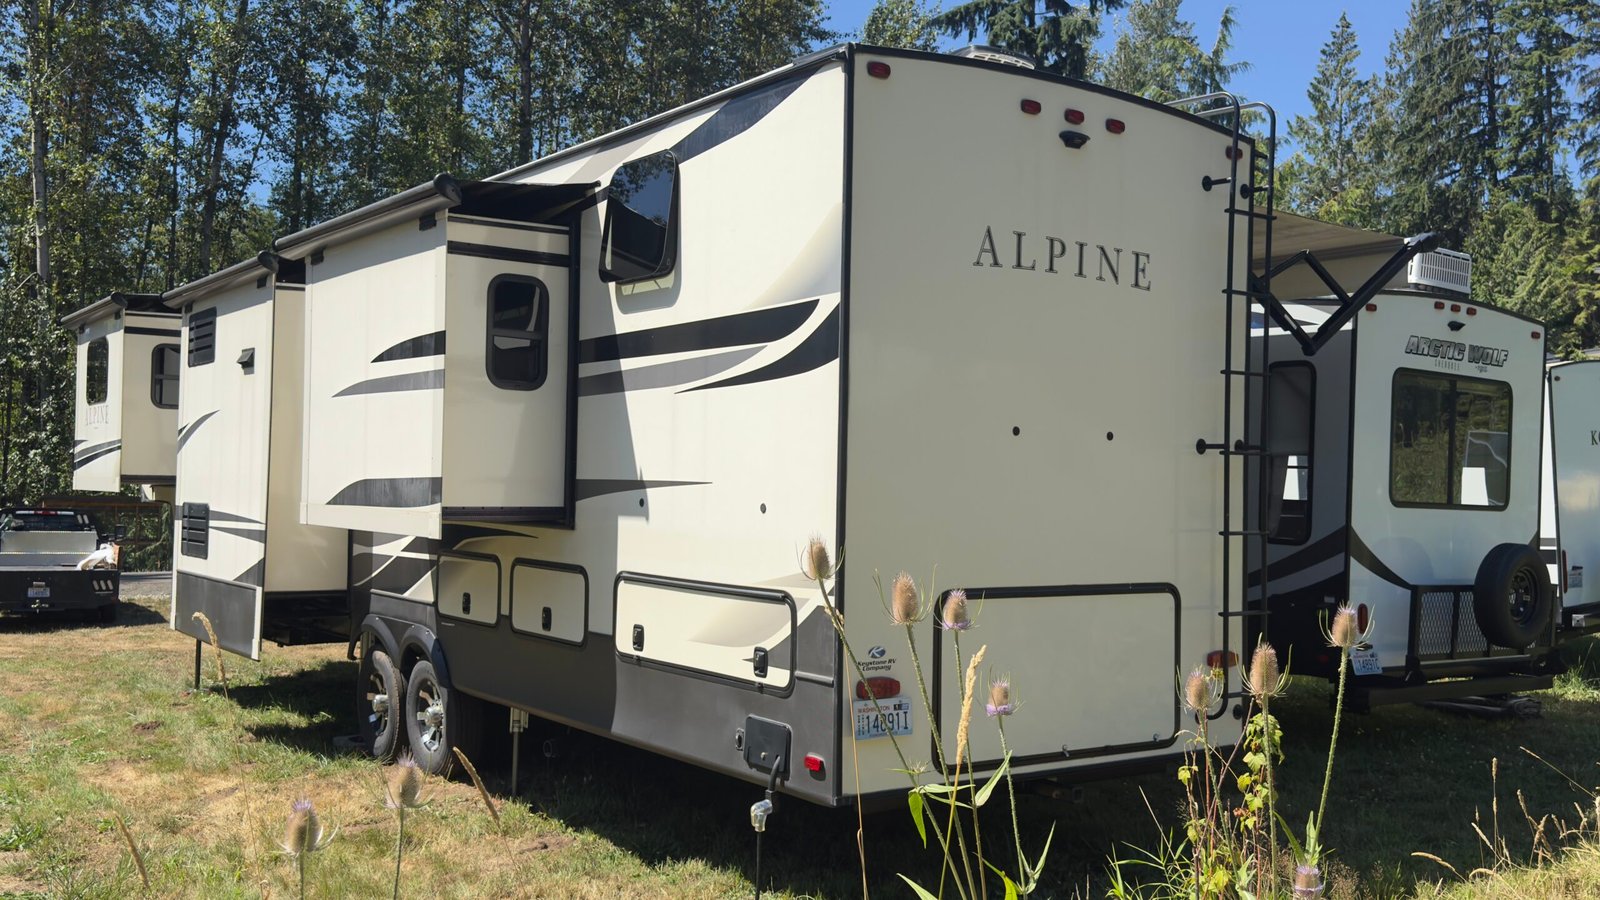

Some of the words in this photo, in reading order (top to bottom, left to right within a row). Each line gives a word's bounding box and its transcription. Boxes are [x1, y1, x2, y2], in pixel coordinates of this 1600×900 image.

[972, 225, 1152, 292] ALPINE
[1405, 335, 1466, 361] ARCTIC
[1468, 344, 1509, 368] WOLF
[857, 659, 887, 667] Keystone
